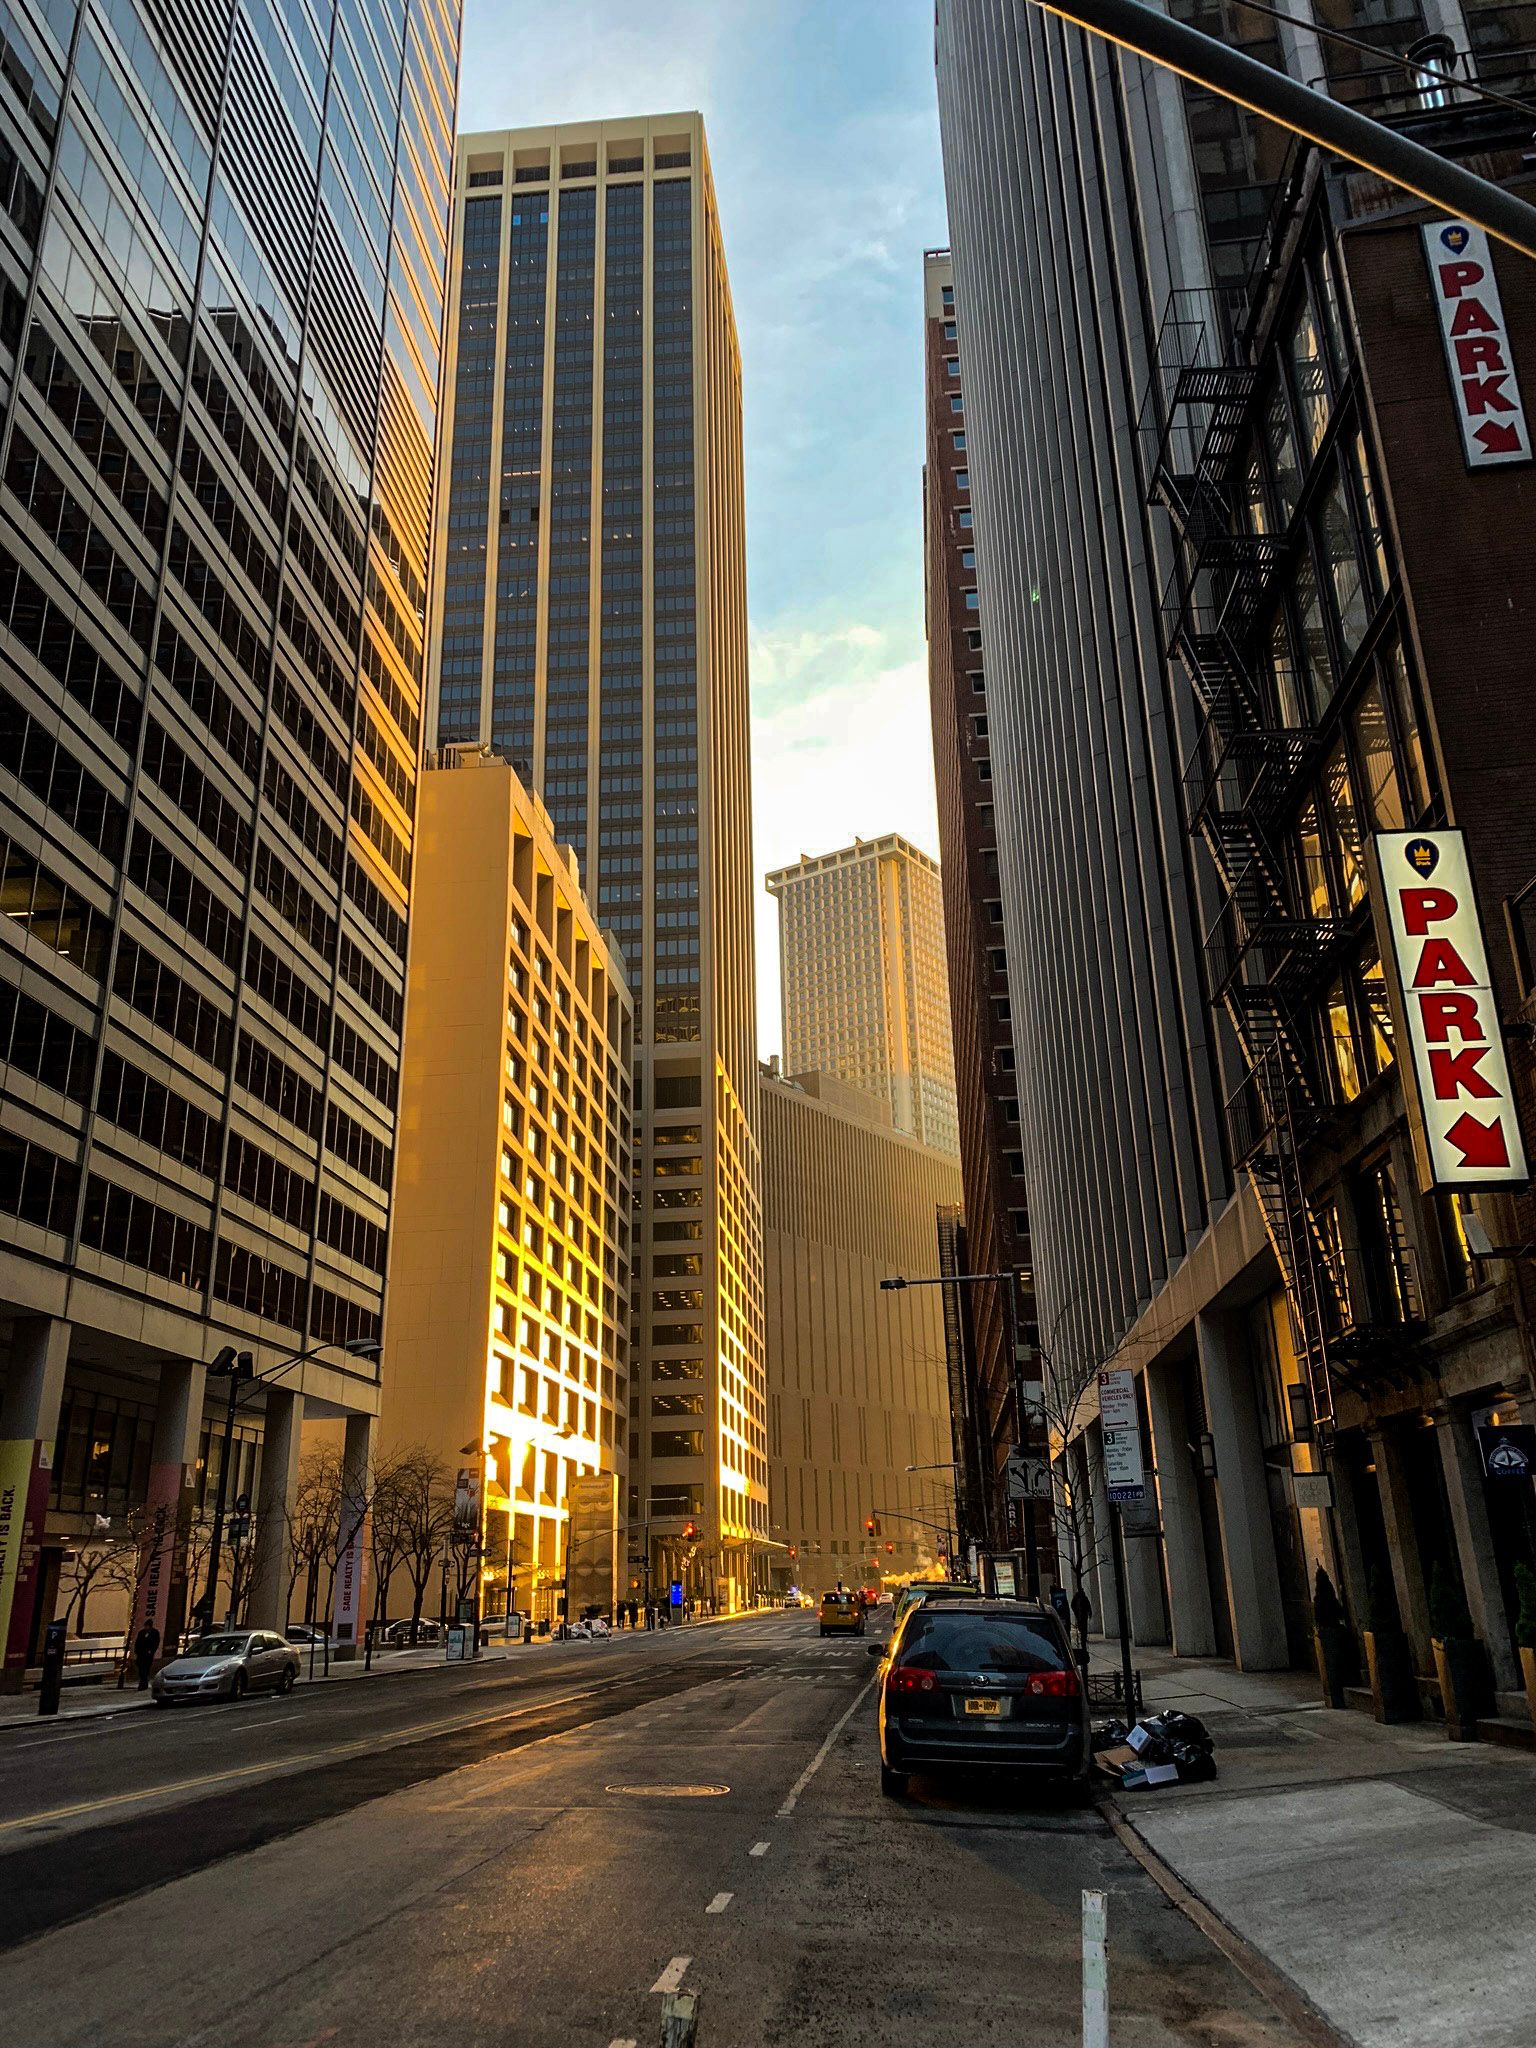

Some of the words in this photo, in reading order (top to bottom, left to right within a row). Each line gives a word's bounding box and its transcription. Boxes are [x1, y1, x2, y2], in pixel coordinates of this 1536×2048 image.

[1438, 260, 1519, 416] PARK
[1399, 887, 1504, 1100] PARK
[1100, 1373, 1107, 1384] 3
[1100, 1387, 1130, 1396] COMMERCIAL
[1101, 1394, 1122, 1402] VEHICLES
[1106, 1432, 1113, 1444] 3
[1033, 1488, 1050, 1496] ONLY
[0, 1484, 16, 1521] BACK.
[344, 1561, 353, 1589] REALTY
